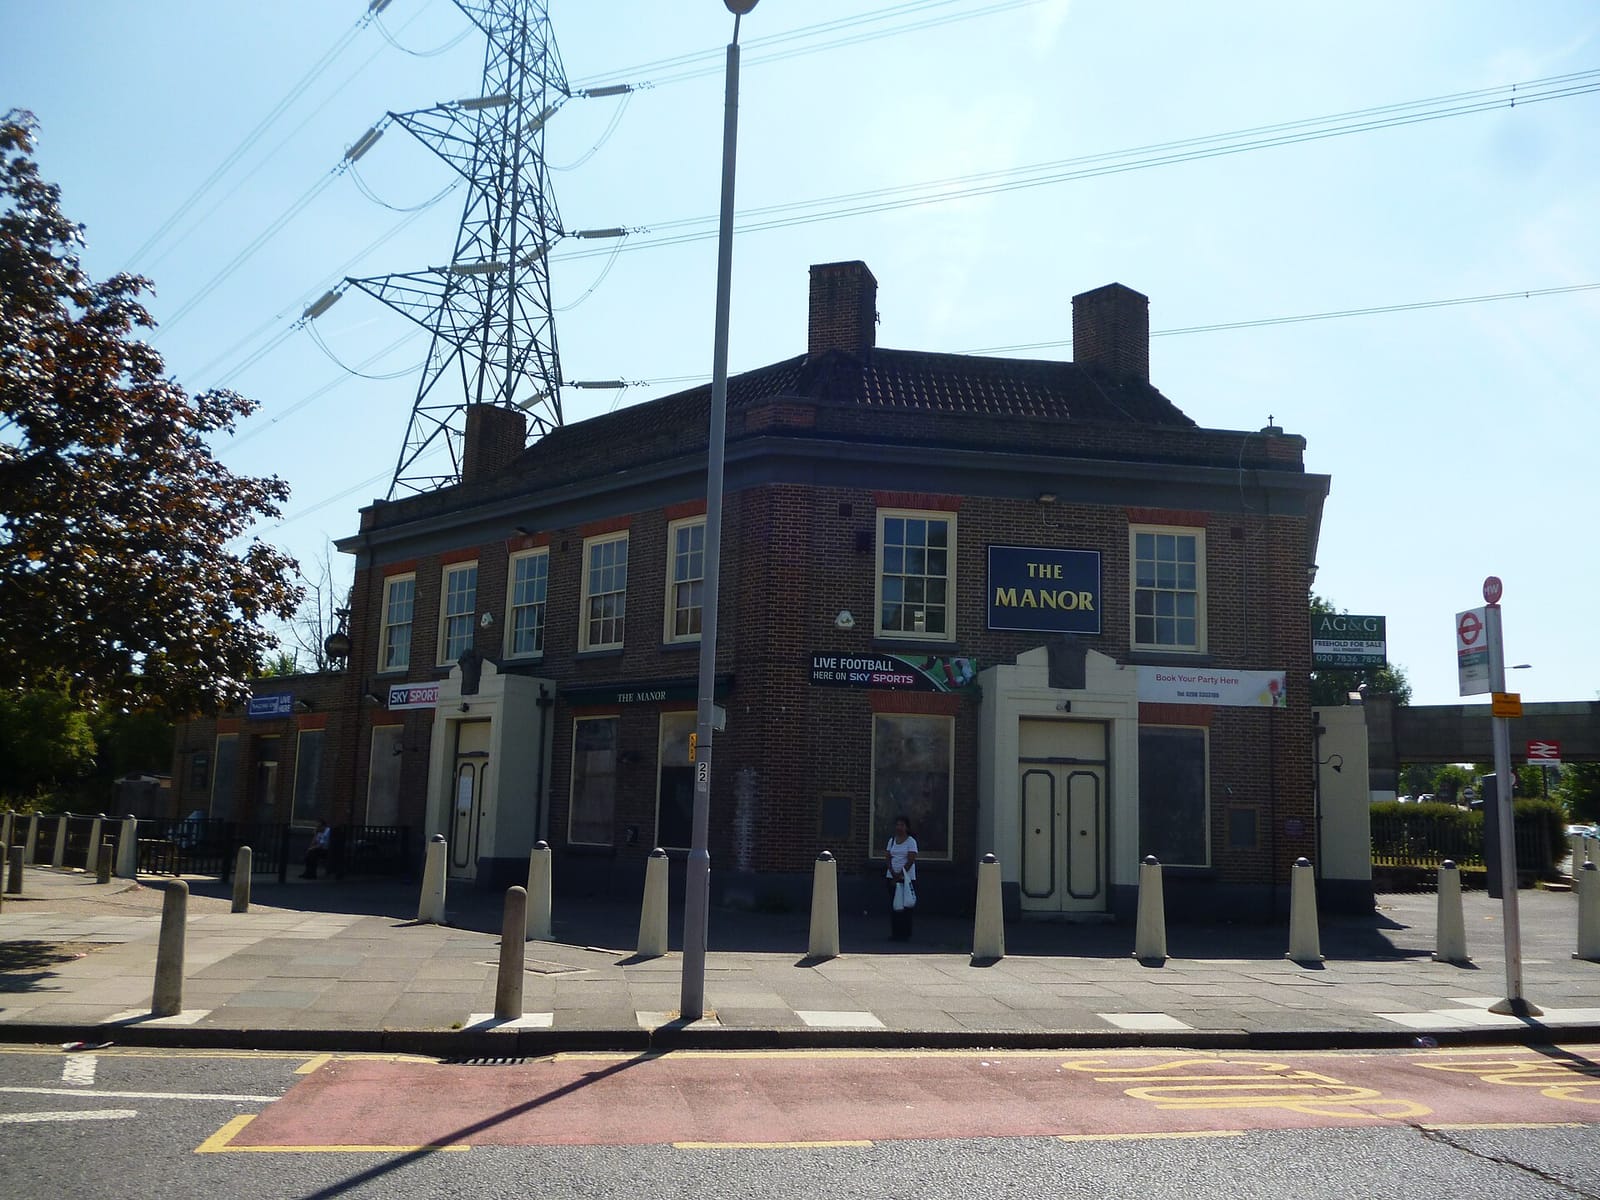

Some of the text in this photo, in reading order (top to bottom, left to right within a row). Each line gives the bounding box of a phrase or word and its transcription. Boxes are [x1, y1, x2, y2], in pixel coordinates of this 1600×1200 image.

[1027, 563, 1063, 579] THE
[995, 587, 1094, 611] MANOR
[1320, 617, 1377, 631] AG&G
[814, 657, 894, 671] LIVE FOOTBALL
[813, 672, 914, 684] HERE ON SKY SPORTS
[1156, 673, 1239, 685] Book Your Party Here
[391, 690, 408, 703] SKY
[617, 691, 666, 702] THE MANOR
[699, 762, 706, 782] 22
[1061, 1058, 1434, 1119] STOP
